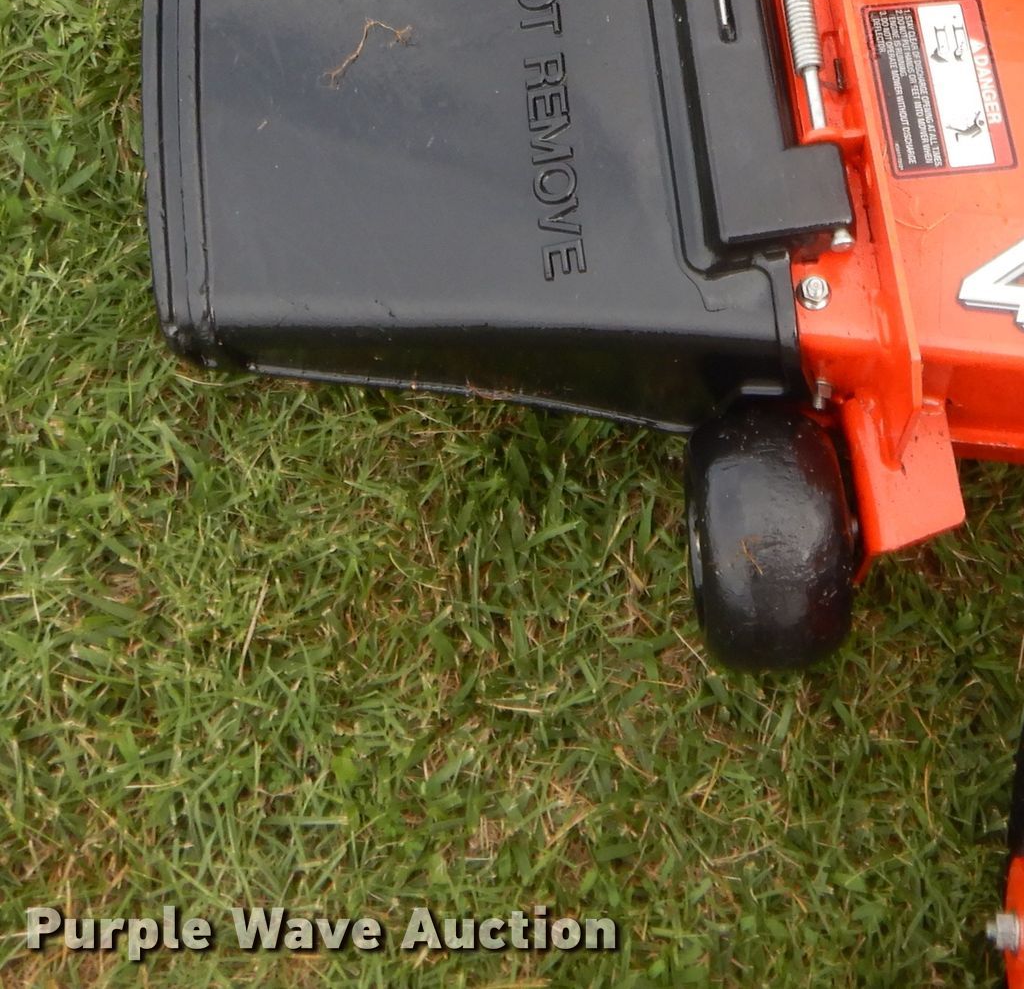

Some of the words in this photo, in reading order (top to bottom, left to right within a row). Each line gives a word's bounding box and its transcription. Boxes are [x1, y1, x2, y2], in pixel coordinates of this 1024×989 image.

[881, 17, 888, 26] DO
[889, 16, 899, 39] ENGINE
[897, 15, 905, 24] DO
[905, 15, 914, 31] STAY
[883, 27, 891, 40] NOT
[899, 25, 907, 38] NOT
[908, 30, 918, 50] CLEAR
[886, 40, 897, 69] OPERATE
[902, 39, 910, 51] PUT
[912, 51, 920, 59] OF
[905, 52, 914, 73] HANDS
[891, 69, 902, 95] MOWER
[909, 74, 916, 83] OR
[914, 59, 927, 94] DISCHARGE
[973, 53, 1002, 123] DANGER
[897, 95, 908, 125] WITHOUT
[914, 101, 923, 116] INTO
[921, 95, 933, 123] OPENING
[917, 117, 928, 143] MOWER
[927, 124, 935, 132] AT
[903, 126, 916, 164] DISCHARGE
[929, 133, 937, 145] ALL
[923, 143, 932, 163] WHEN
[523, 51, 587, 282] REMOVE
